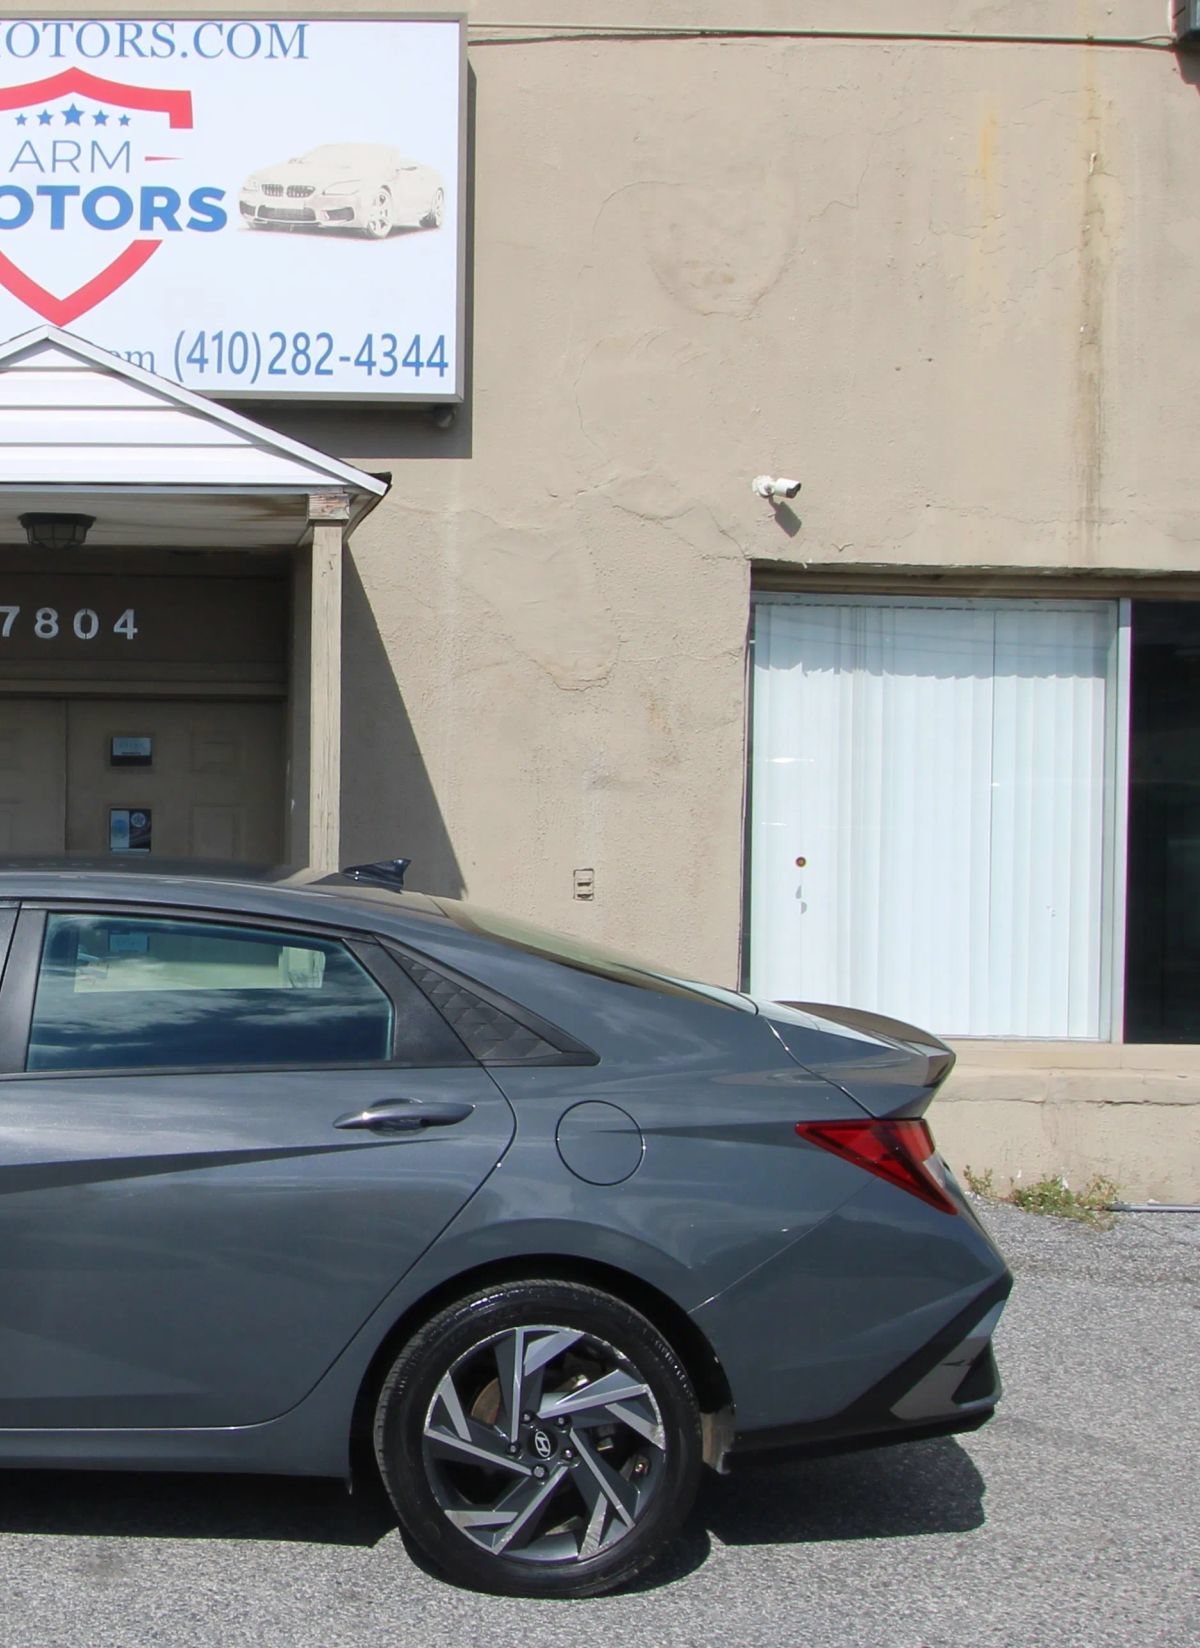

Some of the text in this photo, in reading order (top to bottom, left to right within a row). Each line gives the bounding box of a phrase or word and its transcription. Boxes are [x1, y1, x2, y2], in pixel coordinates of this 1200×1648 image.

[9, 139, 131, 174] ARM
[173, 329, 450, 384] (410)282-4344
[0, 605, 138, 640] 7804
